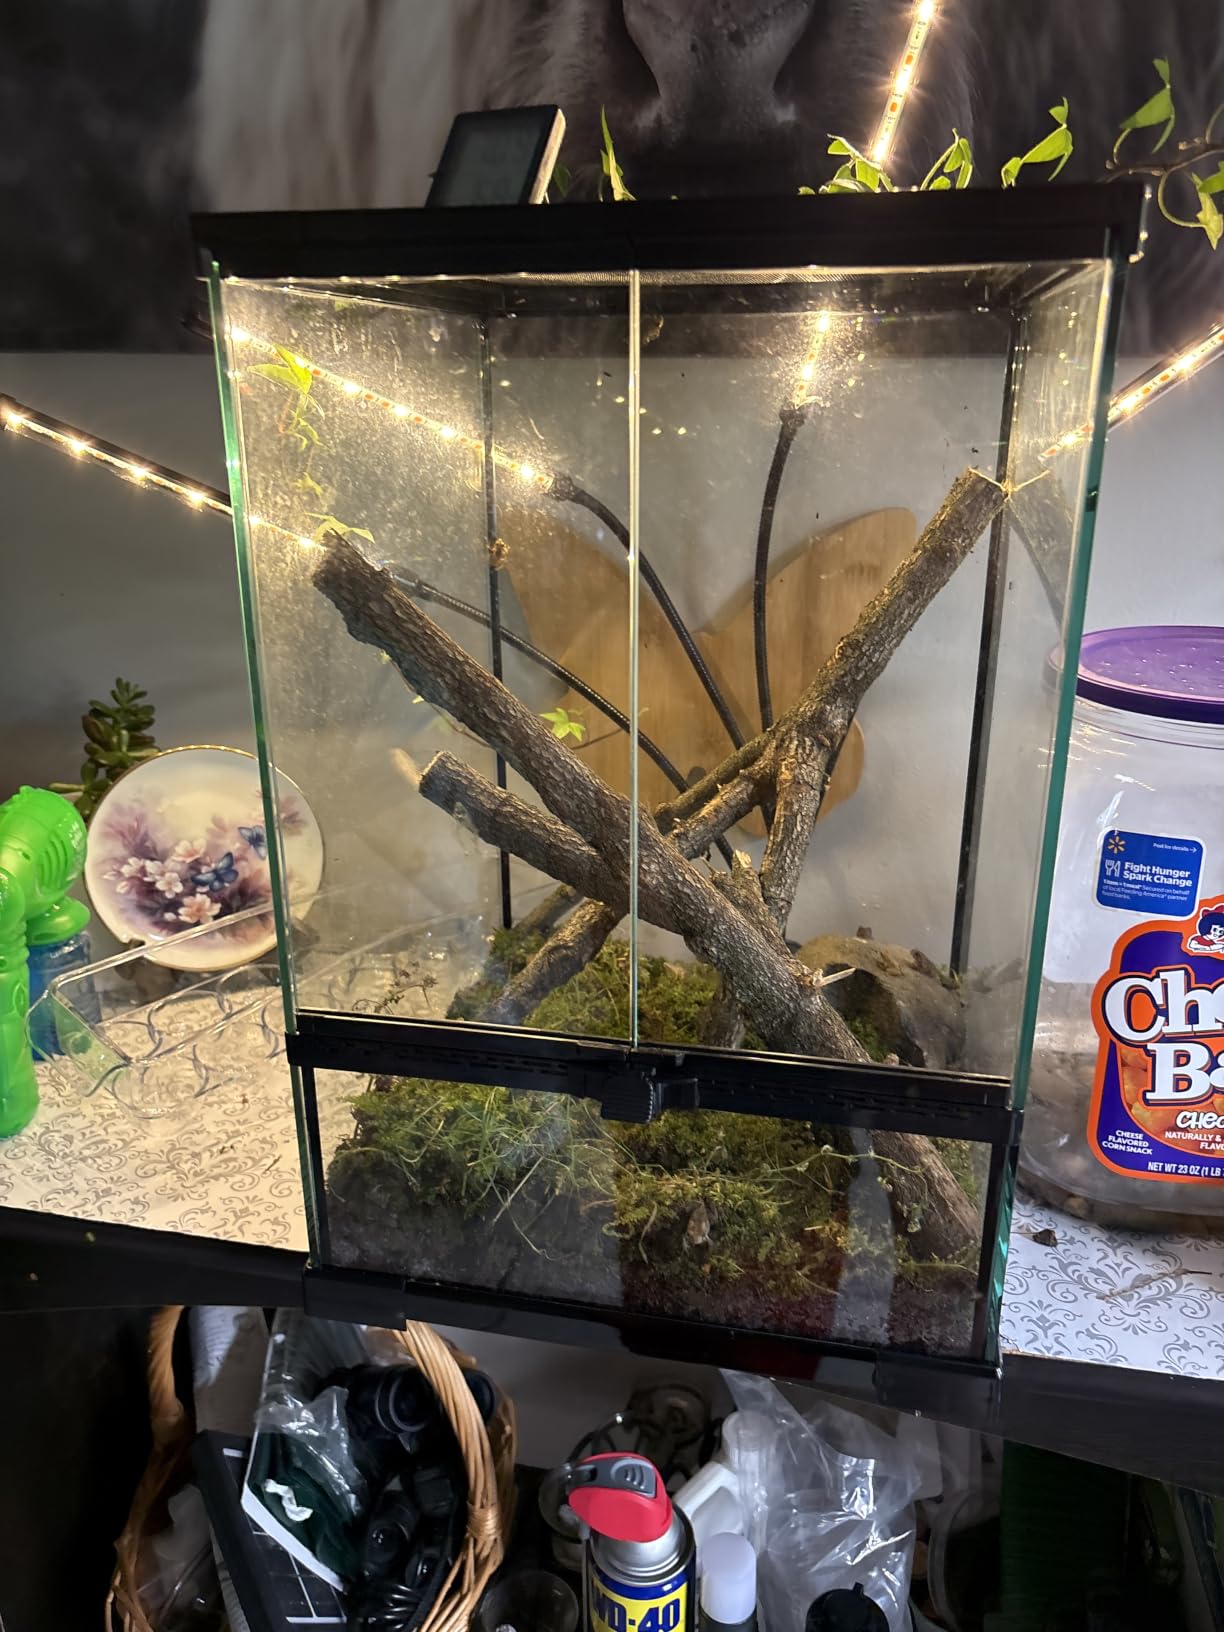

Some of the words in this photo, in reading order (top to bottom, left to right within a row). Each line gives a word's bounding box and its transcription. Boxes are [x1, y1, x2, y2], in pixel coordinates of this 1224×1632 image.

[1125, 862, 1151, 873] Fight
[1152, 866, 1191, 878] Hunger
[1123, 870, 1152, 882] Spark
[1154, 875, 1193, 888] Change
[1108, 1135, 1149, 1147] FLAVORED
[1116, 1130, 1143, 1140] CHEESE
[1165, 1131, 1214, 1141] NATURALLY
[1102, 1141, 1125, 1151] CORN
[1126, 1146, 1153, 1155] SNACK
[1200, 1142, 1224, 1151] FLAV
[1148, 1161, 1163, 1171] NET
[1164, 1163, 1177, 1173] WT
[1178, 1164, 1188, 1174] 23
[1189, 1165, 1200, 1175] OZ
[1201, 1166, 1209, 1177] (1
[1211, 1167, 1221, 1176] LB
